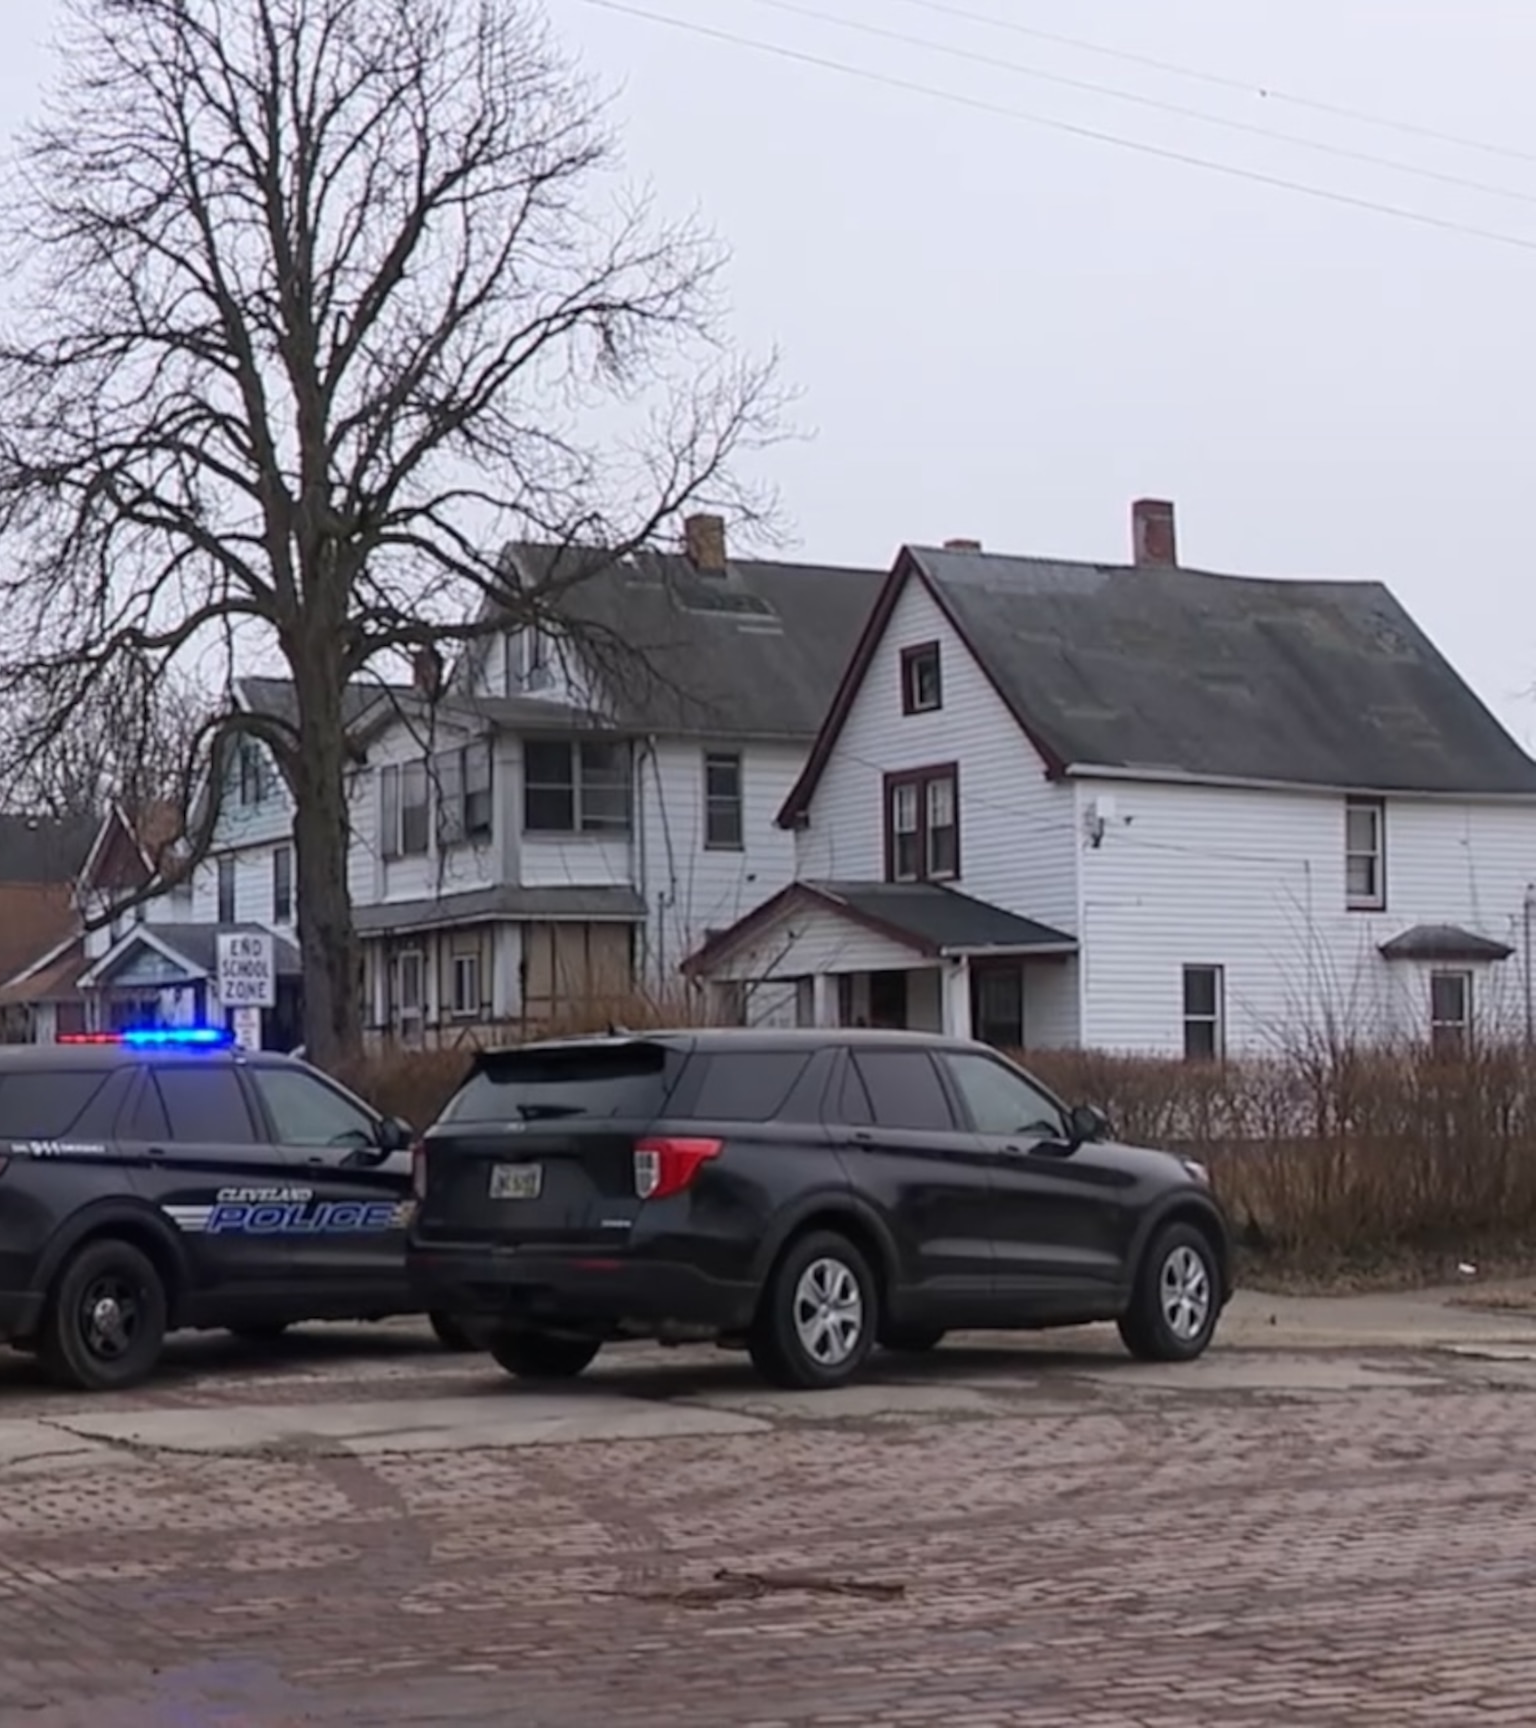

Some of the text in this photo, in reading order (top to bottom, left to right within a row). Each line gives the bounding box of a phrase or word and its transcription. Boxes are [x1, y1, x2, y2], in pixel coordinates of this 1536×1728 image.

[230, 938, 262, 957] END
[222, 960, 269, 979] SCHOOL
[226, 981, 267, 999] ZONE
[217, 1188, 313, 1202] CLEVELAND
[206, 1202, 402, 1232] POLICE
